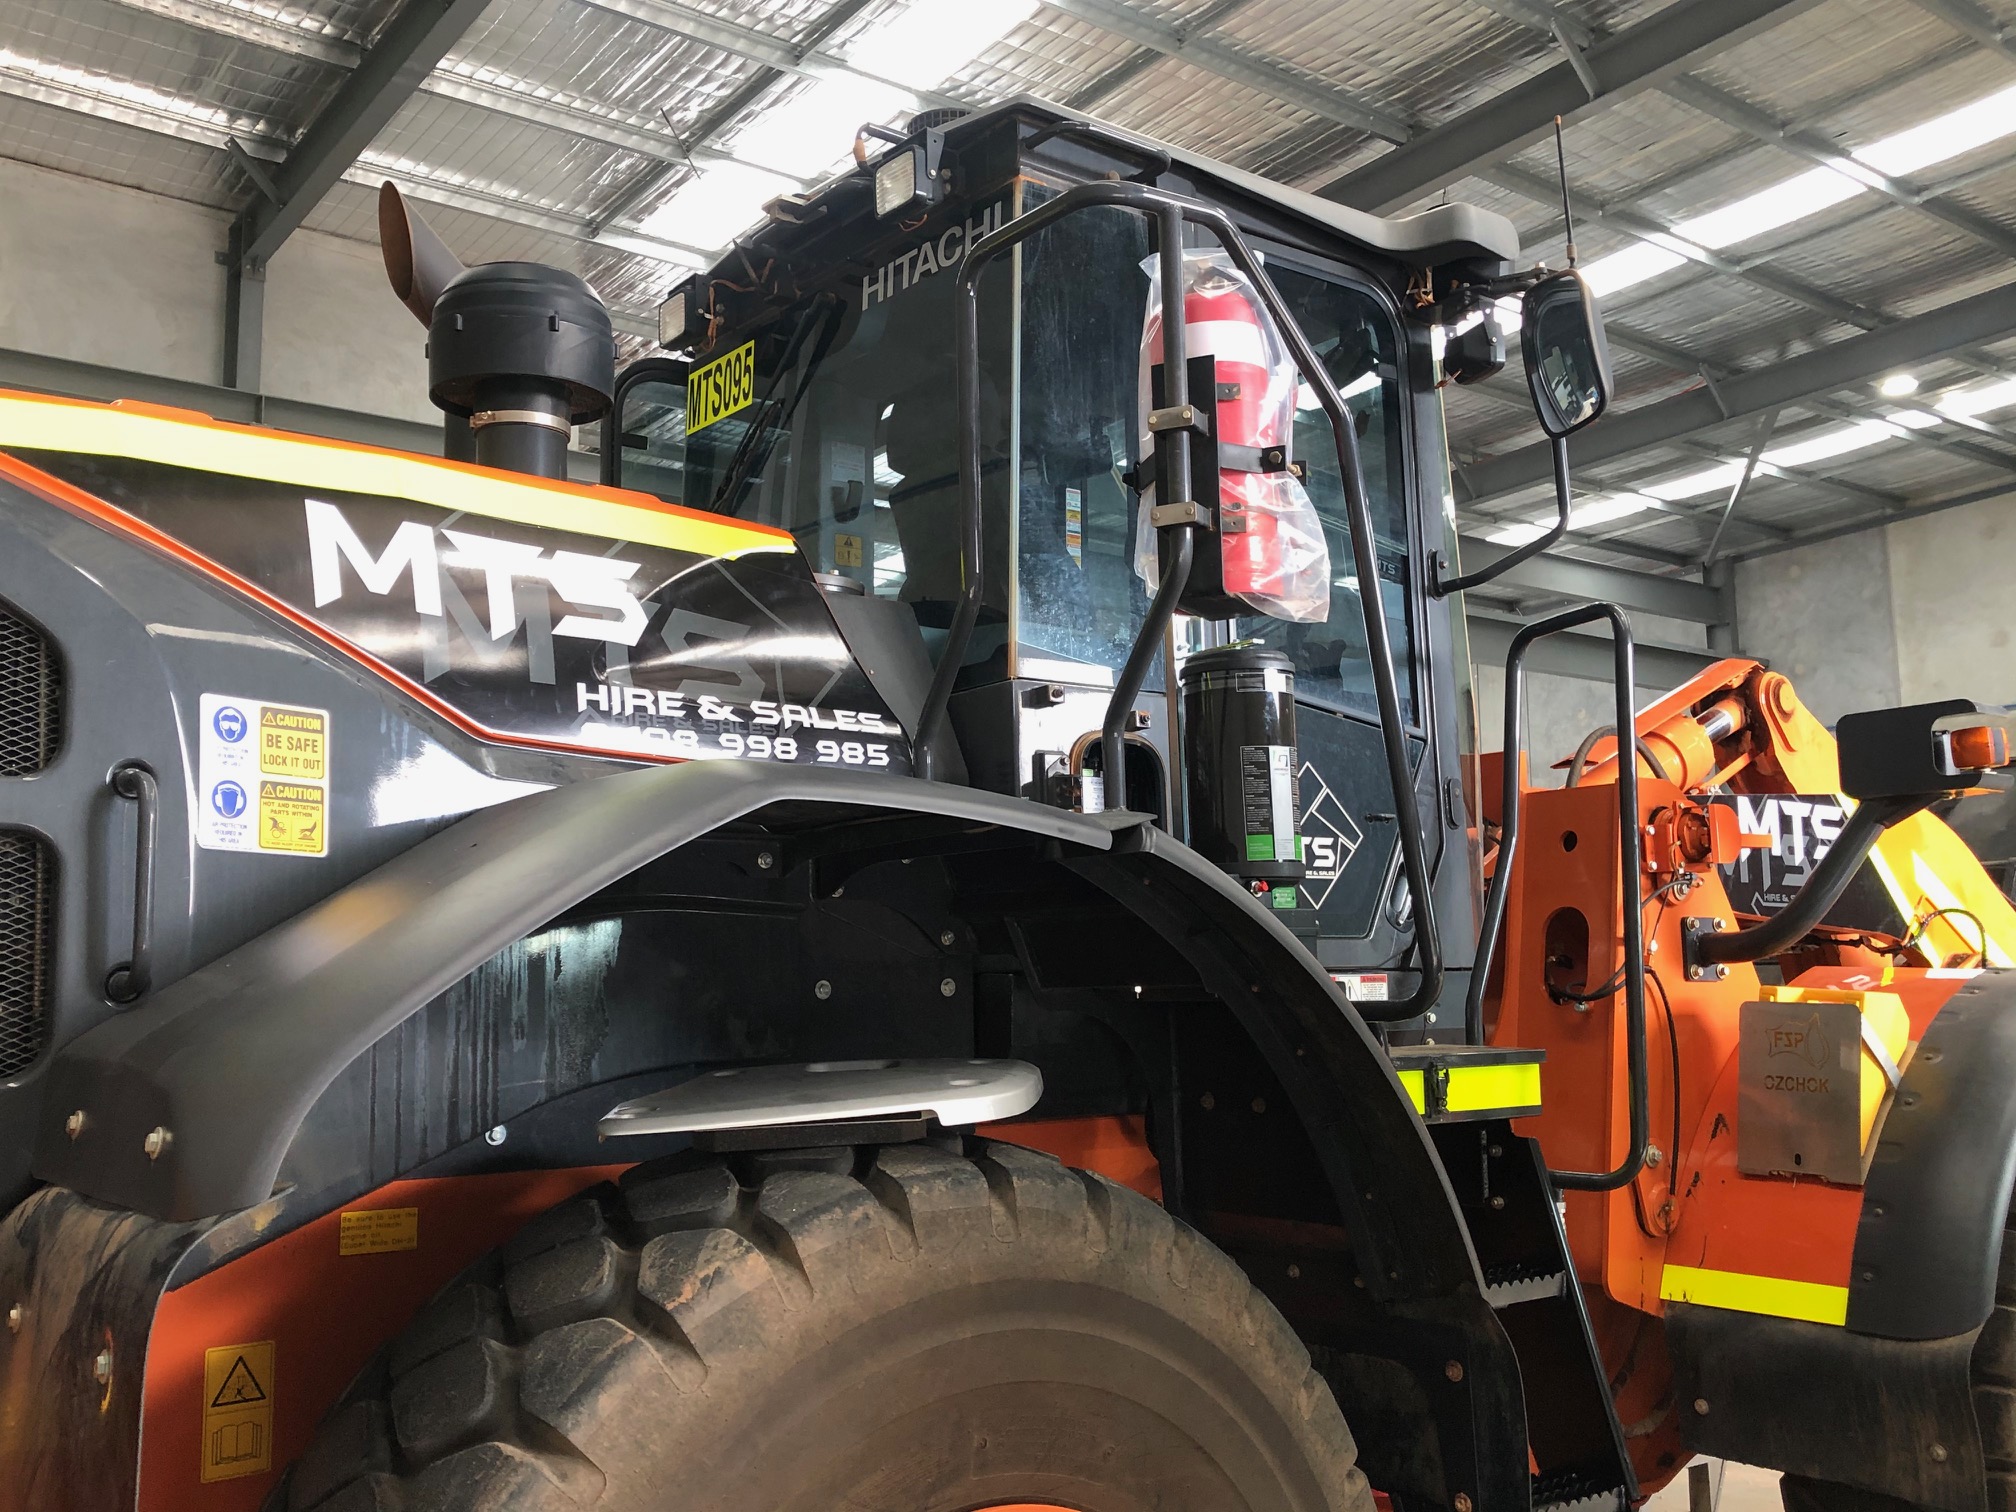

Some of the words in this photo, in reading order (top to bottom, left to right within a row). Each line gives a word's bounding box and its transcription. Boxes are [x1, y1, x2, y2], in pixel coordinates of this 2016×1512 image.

[862, 201, 1002, 311] HITACHI
[688, 346, 753, 431] MTS095
[305, 499, 649, 647] MTS
[576, 682, 687, 717] HIRE
[697, 695, 746, 723] &
[750, 700, 886, 735] SALES
[276, 713, 321, 731] CAUTION
[266, 733, 282, 750] BE
[287, 735, 318, 754] SAFE
[718, 732, 799, 761] 998
[815, 740, 890, 767] 985
[263, 753, 288, 767] LOCK
[291, 757, 300, 768] IT
[303, 758, 321, 770] OUT
[276, 785, 322, 801] CAUTION
[292, 804, 320, 812] ROTATING
[1737, 796, 1843, 866] MTS
[1764, 893, 1781, 902] HIRE
[1764, 1075, 1829, 1093] OZCHOK
